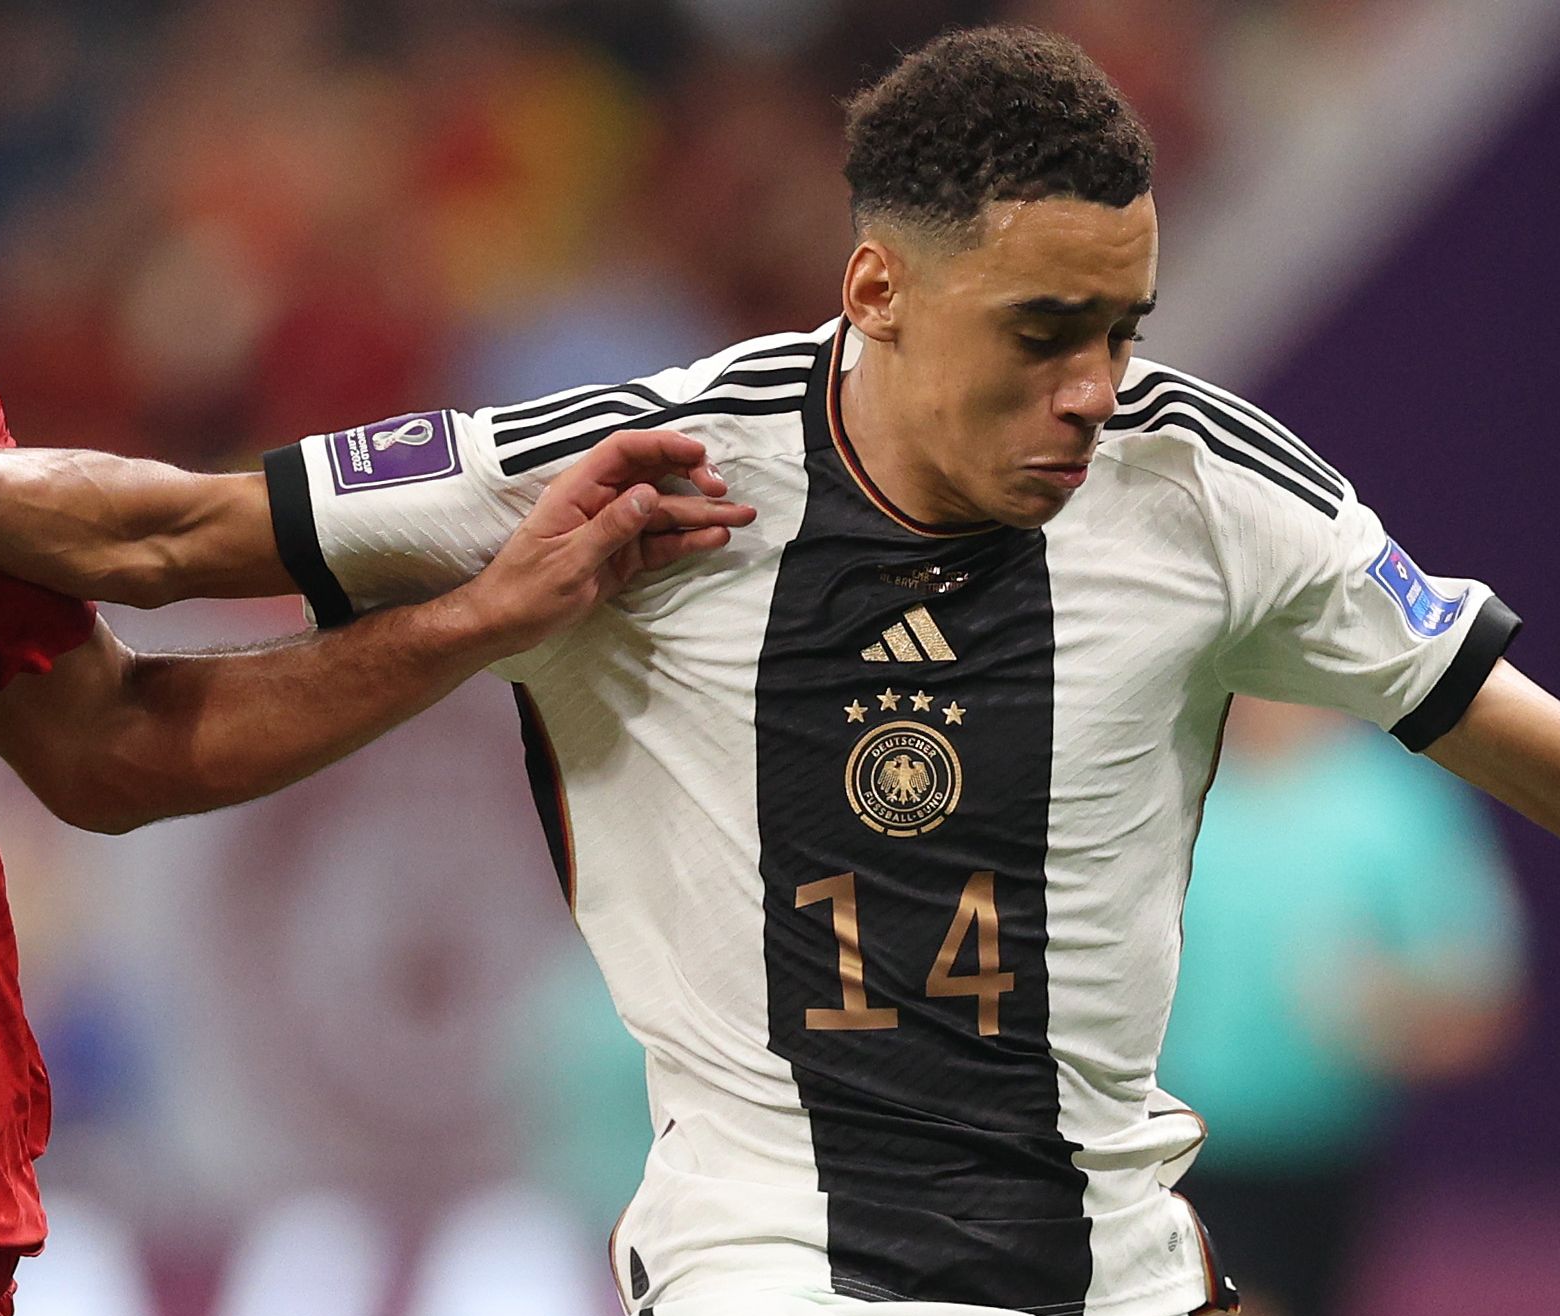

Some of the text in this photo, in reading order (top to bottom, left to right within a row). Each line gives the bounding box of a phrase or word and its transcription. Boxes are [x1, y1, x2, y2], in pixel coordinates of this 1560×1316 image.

[871, 736, 937, 759] DEUTSCHER
[863, 790, 944, 823] FUSSBALL-BUND
[794, 870, 1015, 1037] 14
